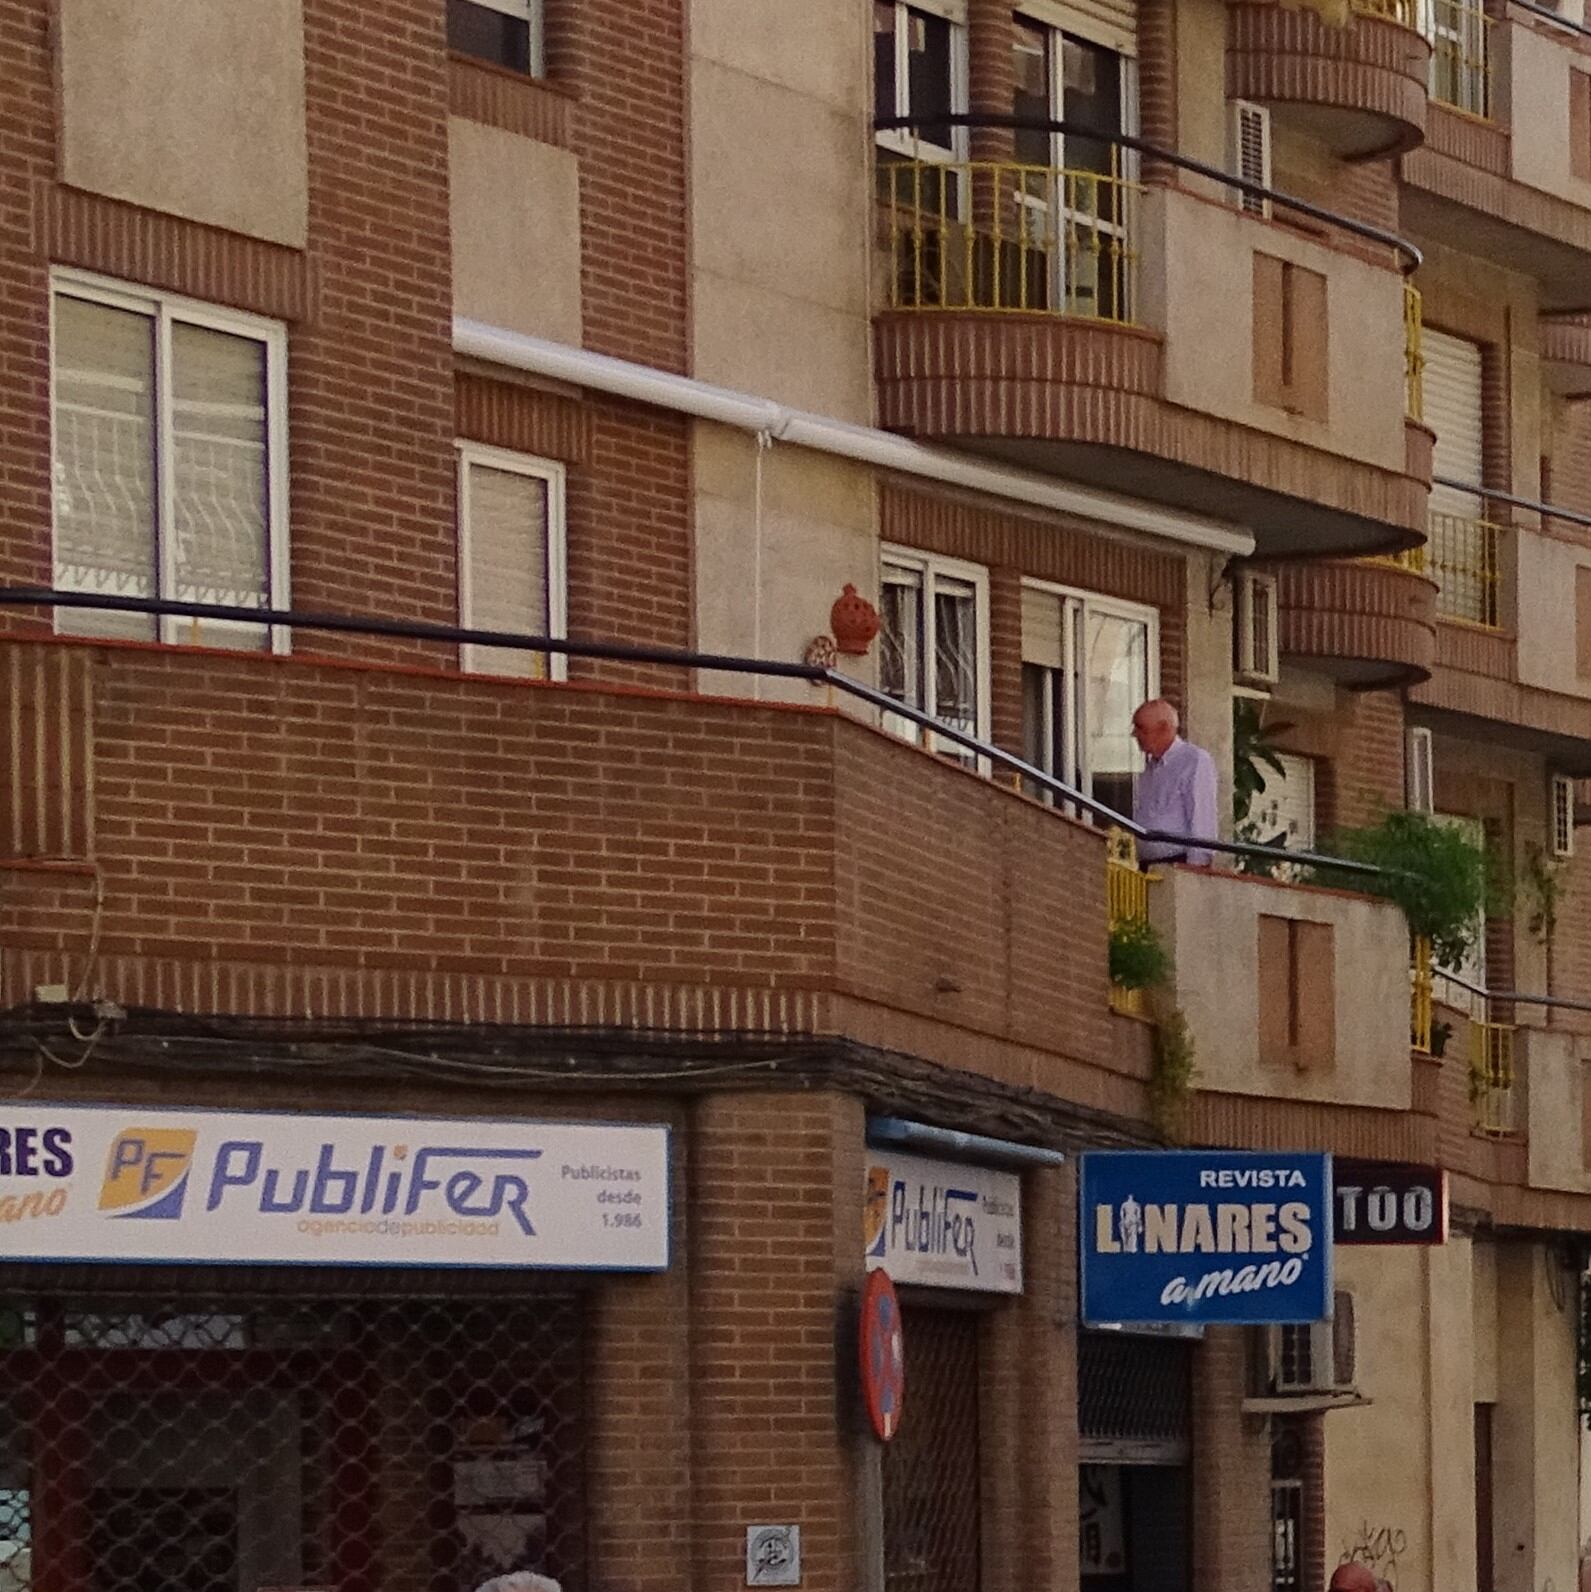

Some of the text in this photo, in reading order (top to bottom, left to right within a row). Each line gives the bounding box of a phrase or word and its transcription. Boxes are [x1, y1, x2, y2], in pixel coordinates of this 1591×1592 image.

[561, 1165, 641, 1181] Publicistas
[1200, 1169, 1307, 1188] REVISTA
[597, 1189, 641, 1205] desde
[1160, 1257, 1304, 1305] a mano
